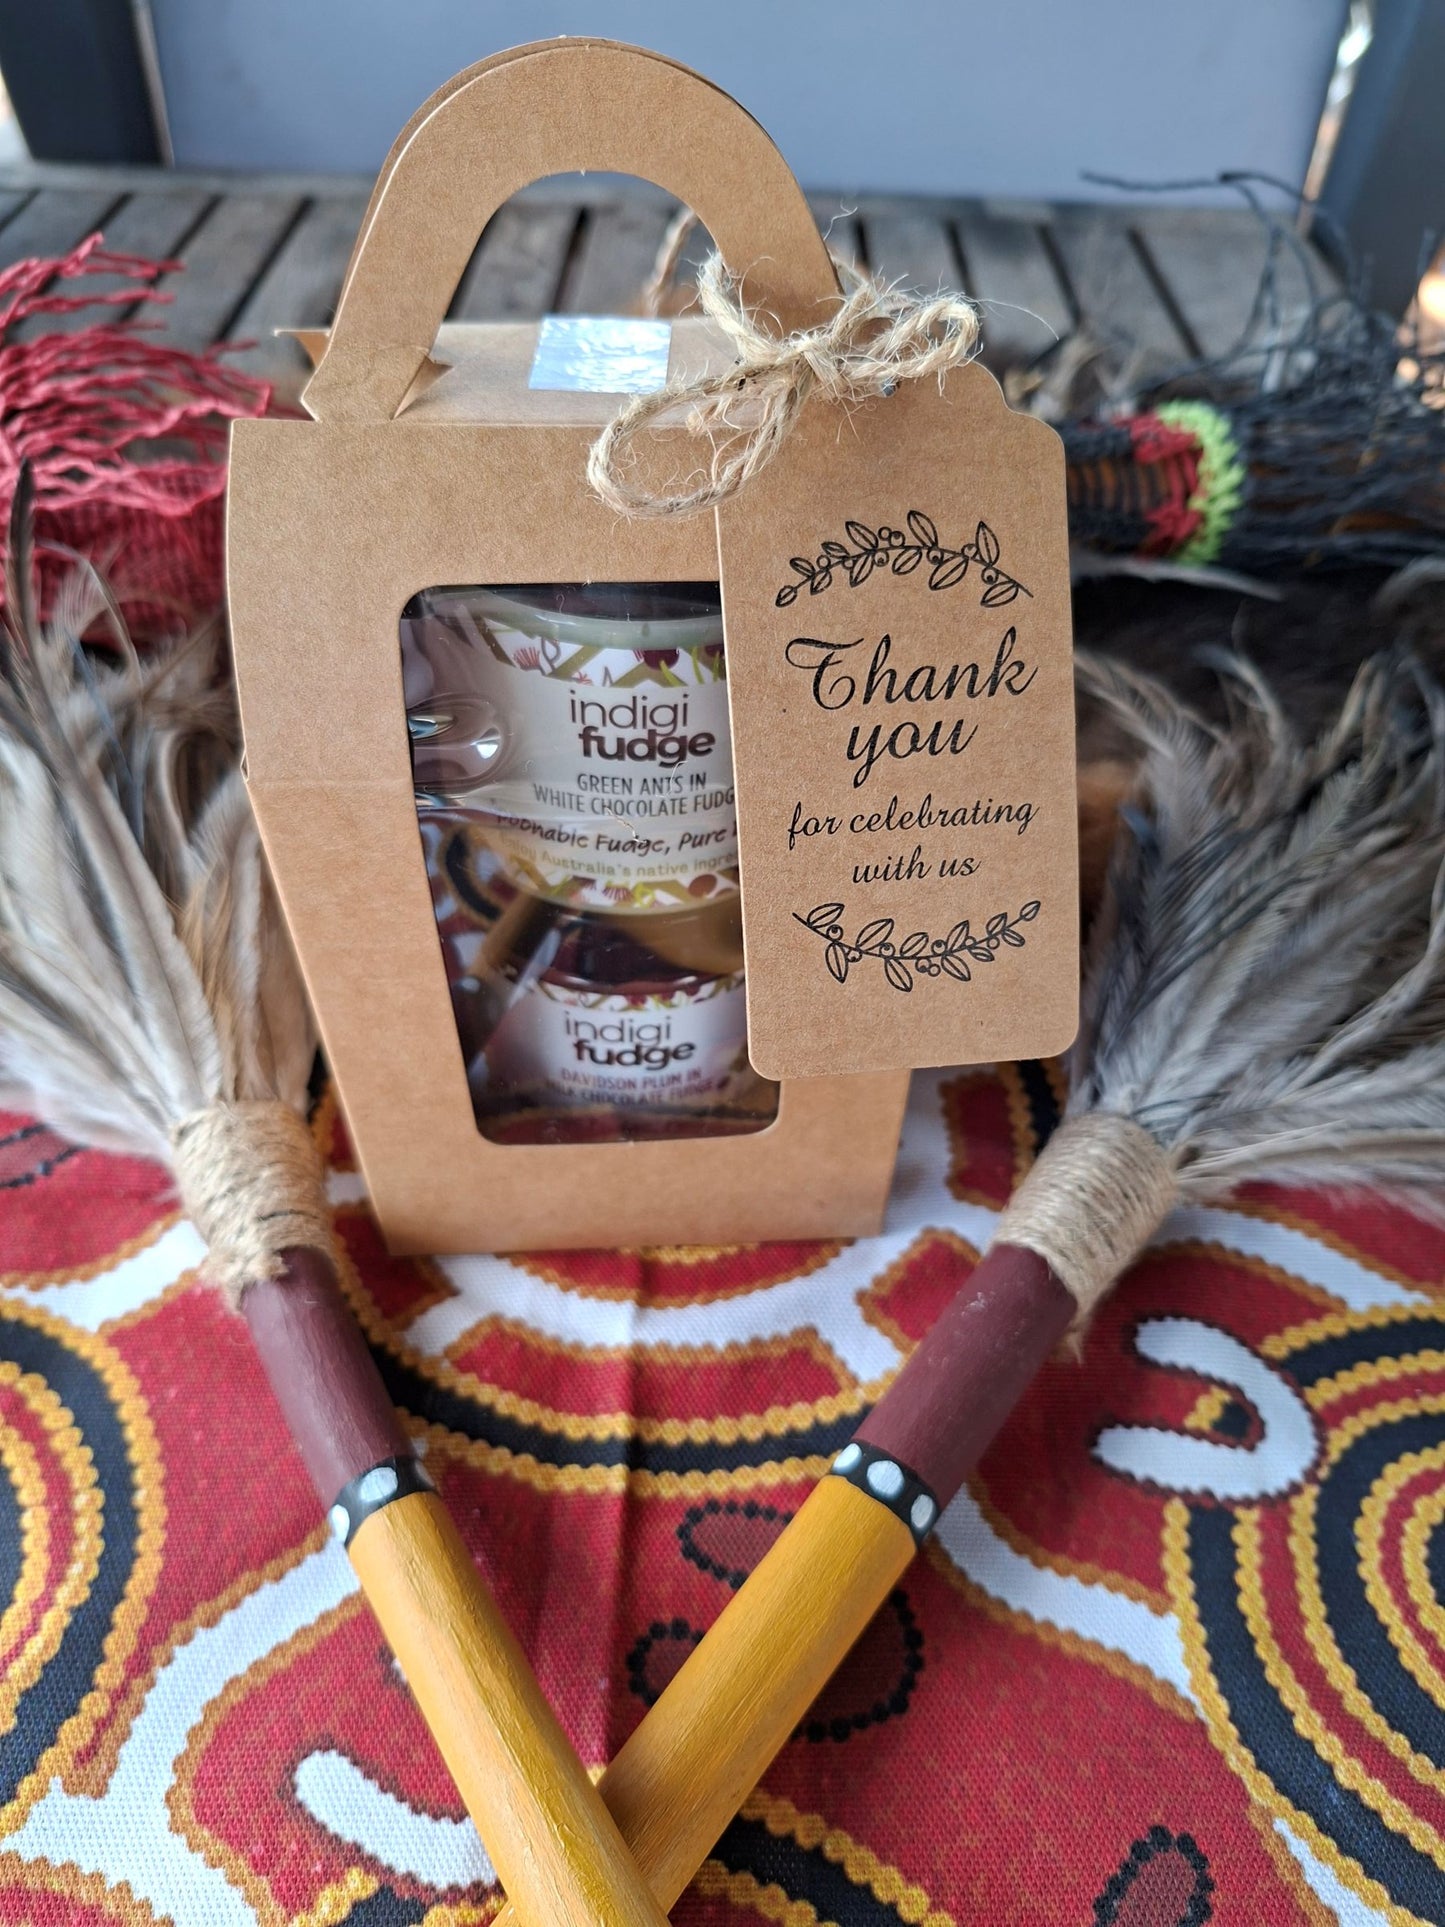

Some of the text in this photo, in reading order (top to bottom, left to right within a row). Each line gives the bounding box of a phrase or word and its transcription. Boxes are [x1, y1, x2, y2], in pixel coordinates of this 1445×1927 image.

[785, 626, 1039, 710] Thank
[570, 689, 690, 737] indigi
[578, 725, 716, 769] fudge
[846, 719, 979, 789] you
[533, 782, 585, 813] WHITE
[590, 797, 688, 817] CHOCOLATE
[577, 772, 707, 796] GREEN ANTS IN
[787, 801, 843, 851] for
[849, 793, 1040, 836] celebrating
[595, 833, 671, 857] Fudge,
[678, 828, 727, 851] Pure
[636, 862, 689, 877] native
[852, 844, 982, 884] with us
[564, 1010, 672, 1046] indigi
[573, 1039, 696, 1071] fudge
[561, 1067, 702, 1090] DAVIDSON PLUM IN
